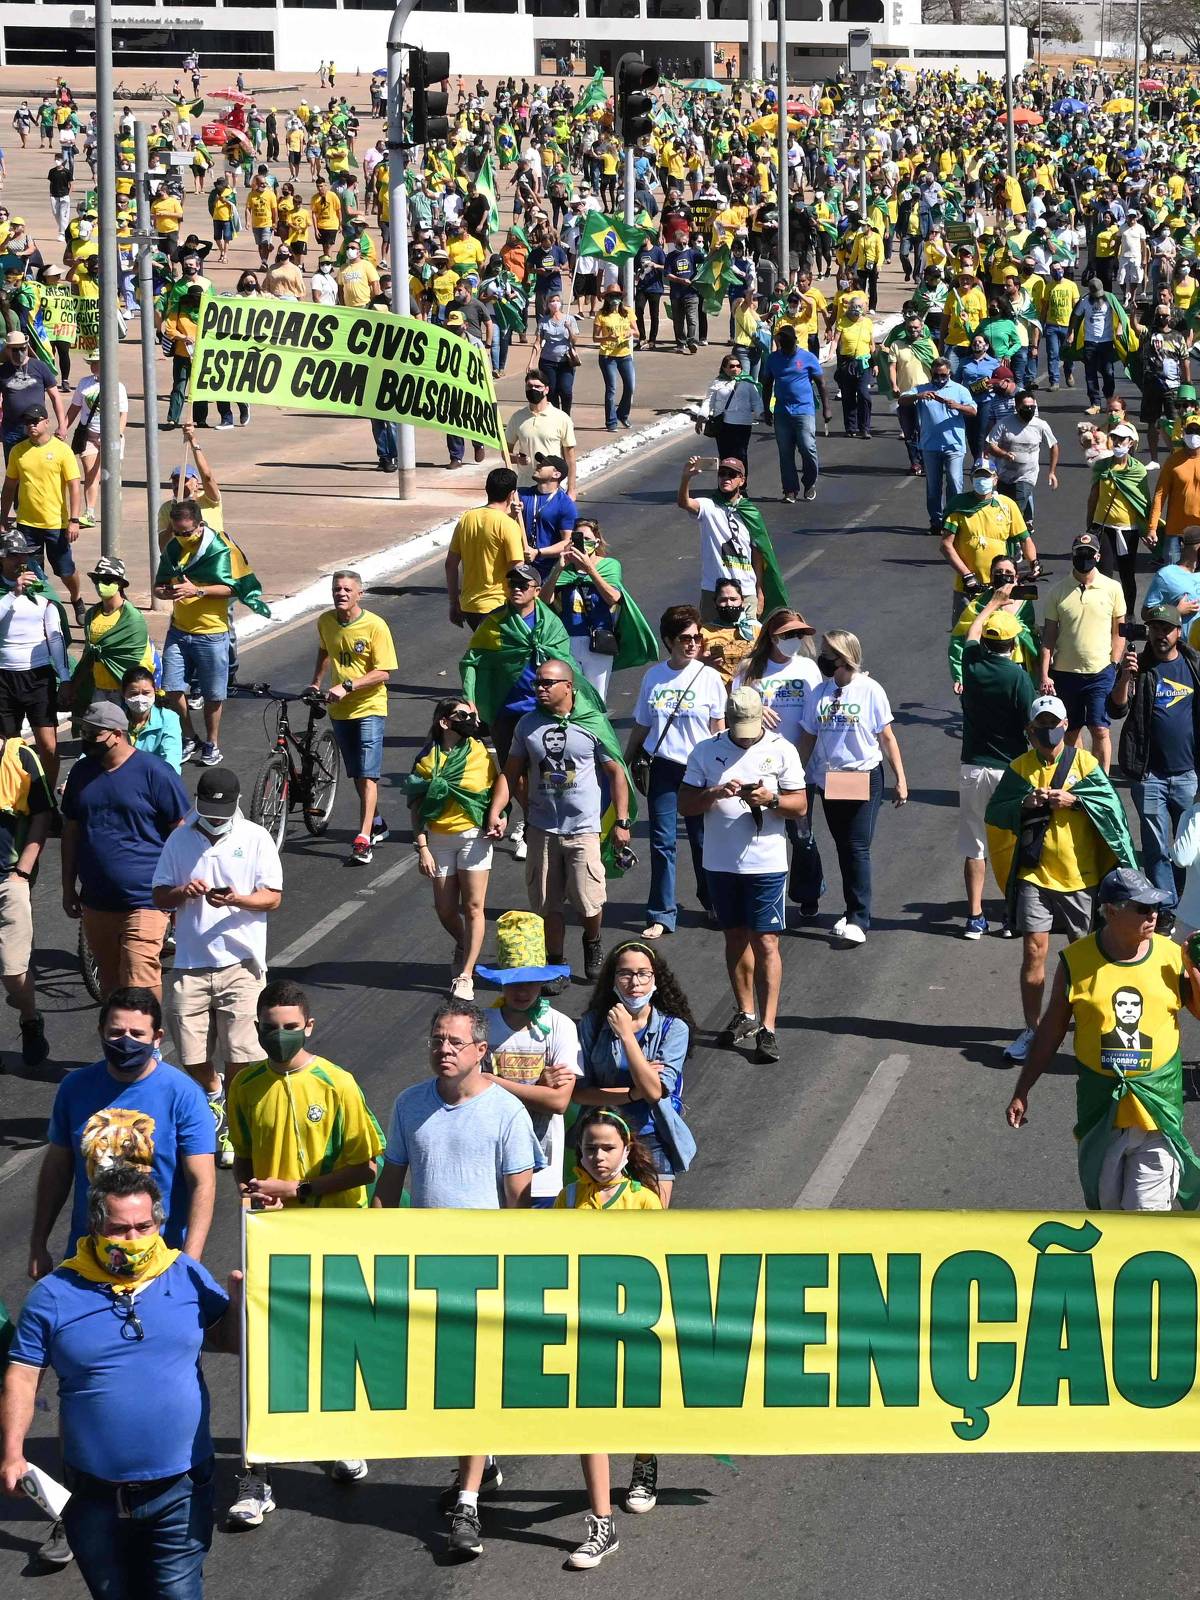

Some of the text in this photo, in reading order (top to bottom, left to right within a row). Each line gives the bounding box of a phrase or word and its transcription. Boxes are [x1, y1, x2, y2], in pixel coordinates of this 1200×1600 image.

[201, 301, 485, 390] POLICIAIS CIVIS DO DF
[196, 346, 283, 394] ESTÃO
[290, 356, 370, 407] COM
[654, 690, 696, 701] VOTO
[759, 679, 804, 690] VOTO
[1101, 1056, 1150, 1068] Bolsonaro 17
[267, 1219, 1198, 1442] INTERVENÇÃO
